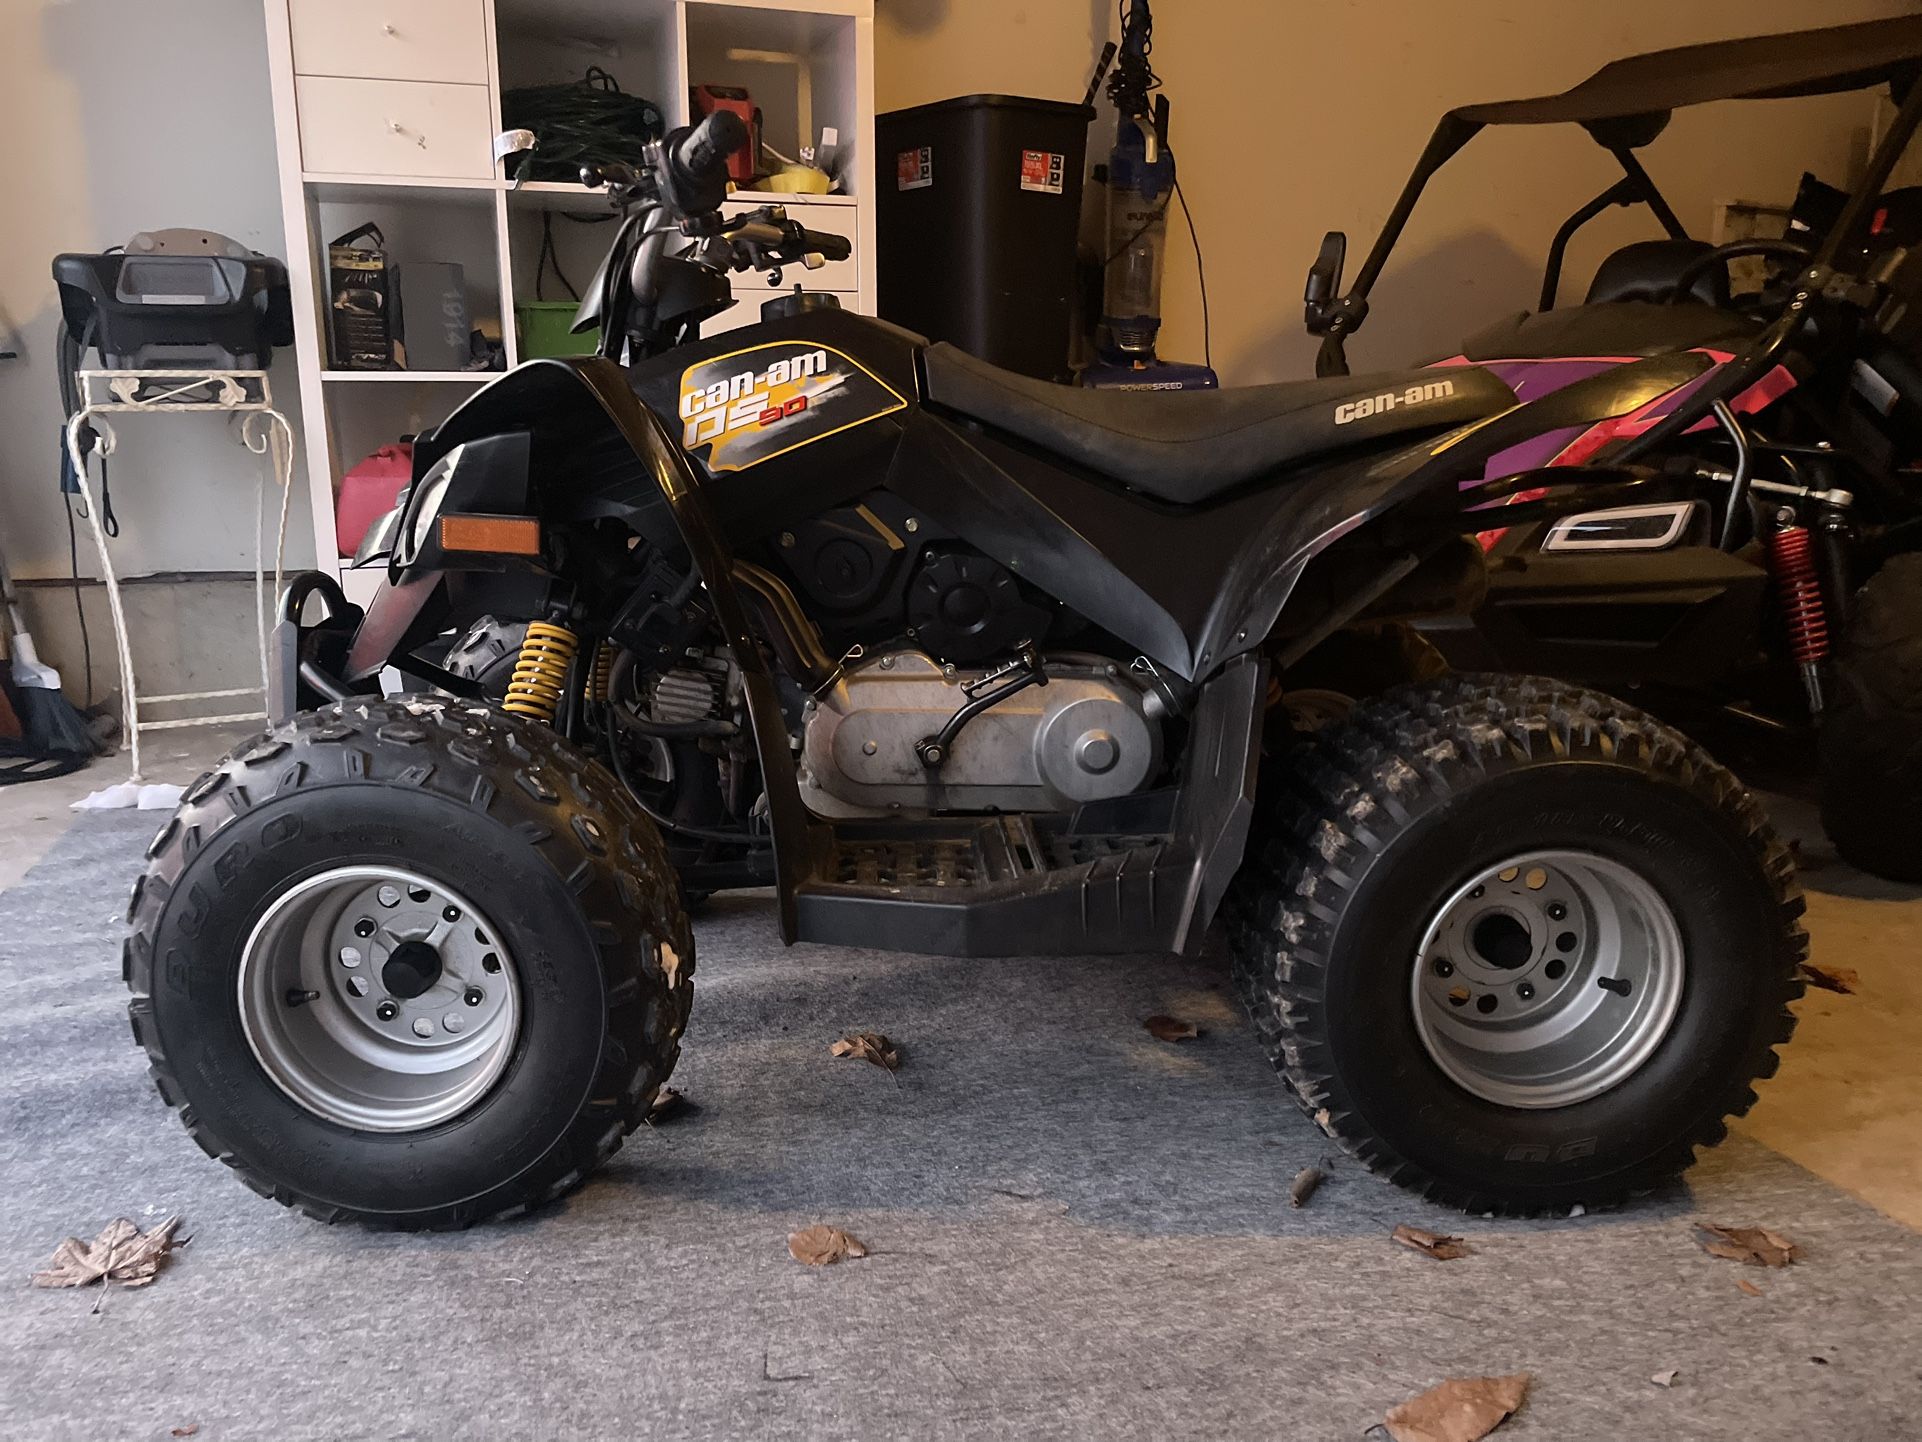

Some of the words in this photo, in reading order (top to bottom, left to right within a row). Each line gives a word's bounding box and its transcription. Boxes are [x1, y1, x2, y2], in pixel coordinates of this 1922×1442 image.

[680, 349, 827, 420] can-am
[1119, 381, 1183, 392] POWERSPEED
[1334, 380, 1454, 425] can-am
[165, 811, 304, 1000] DURO
